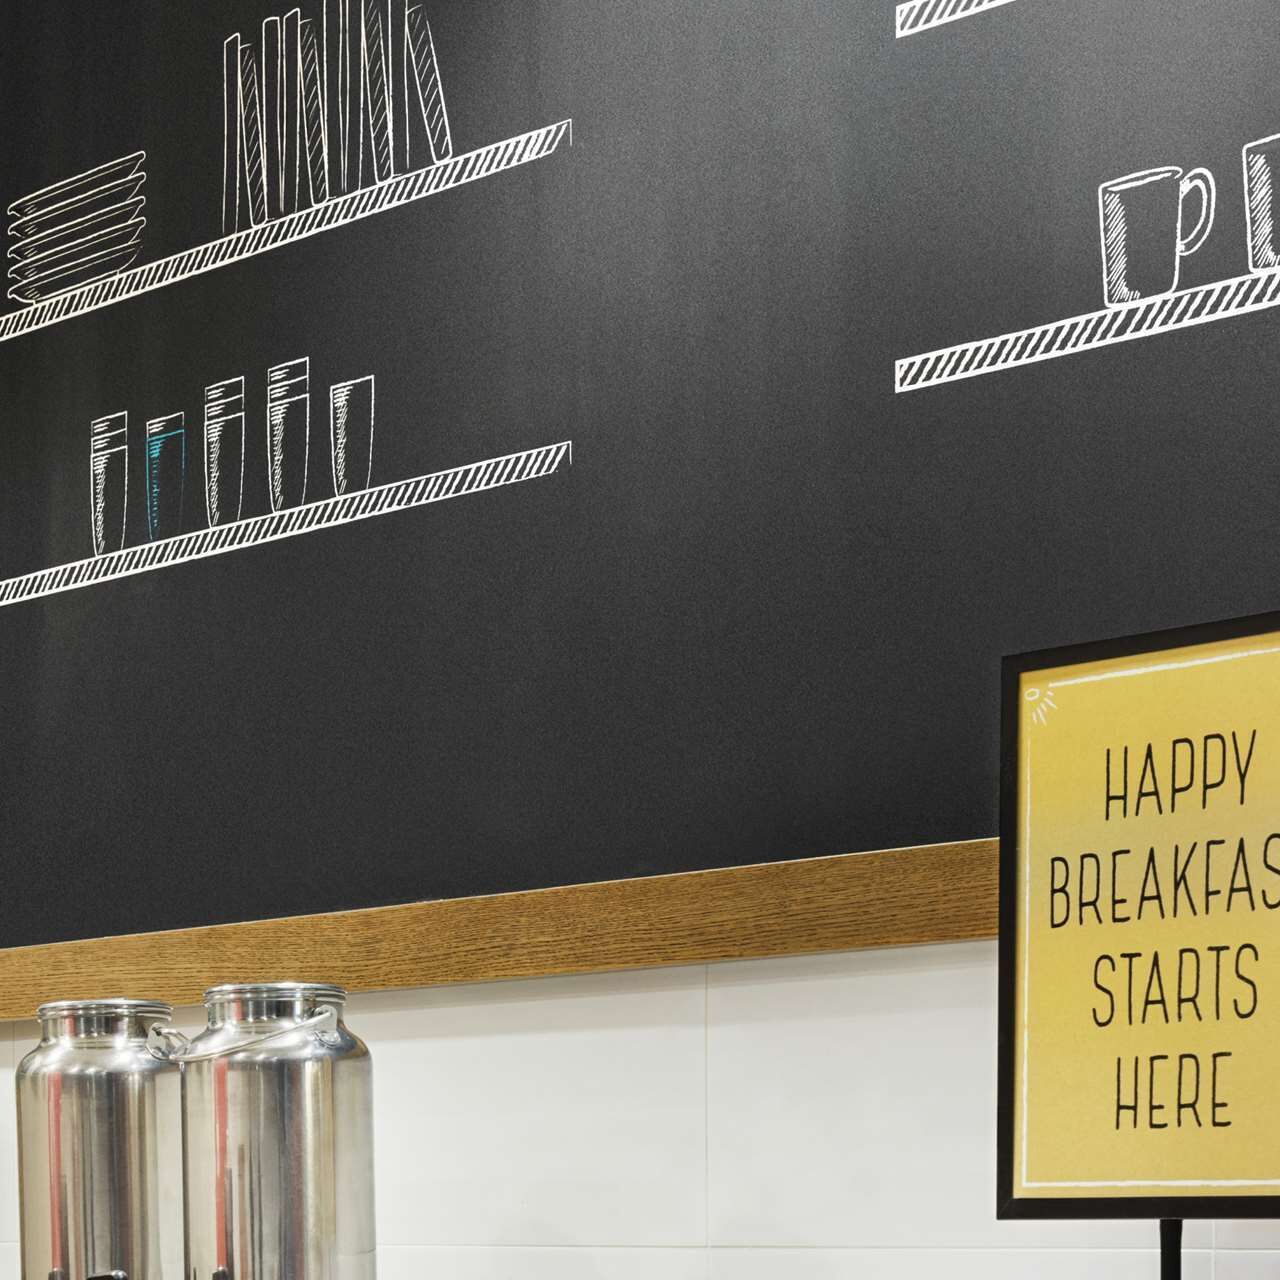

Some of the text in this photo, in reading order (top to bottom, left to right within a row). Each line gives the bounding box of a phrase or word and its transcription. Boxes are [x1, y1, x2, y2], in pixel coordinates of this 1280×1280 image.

[1104, 729, 1257, 821] HAPPY
[1092, 943, 1259, 1028] STARTS
[1115, 1051, 1233, 1130] HERE
